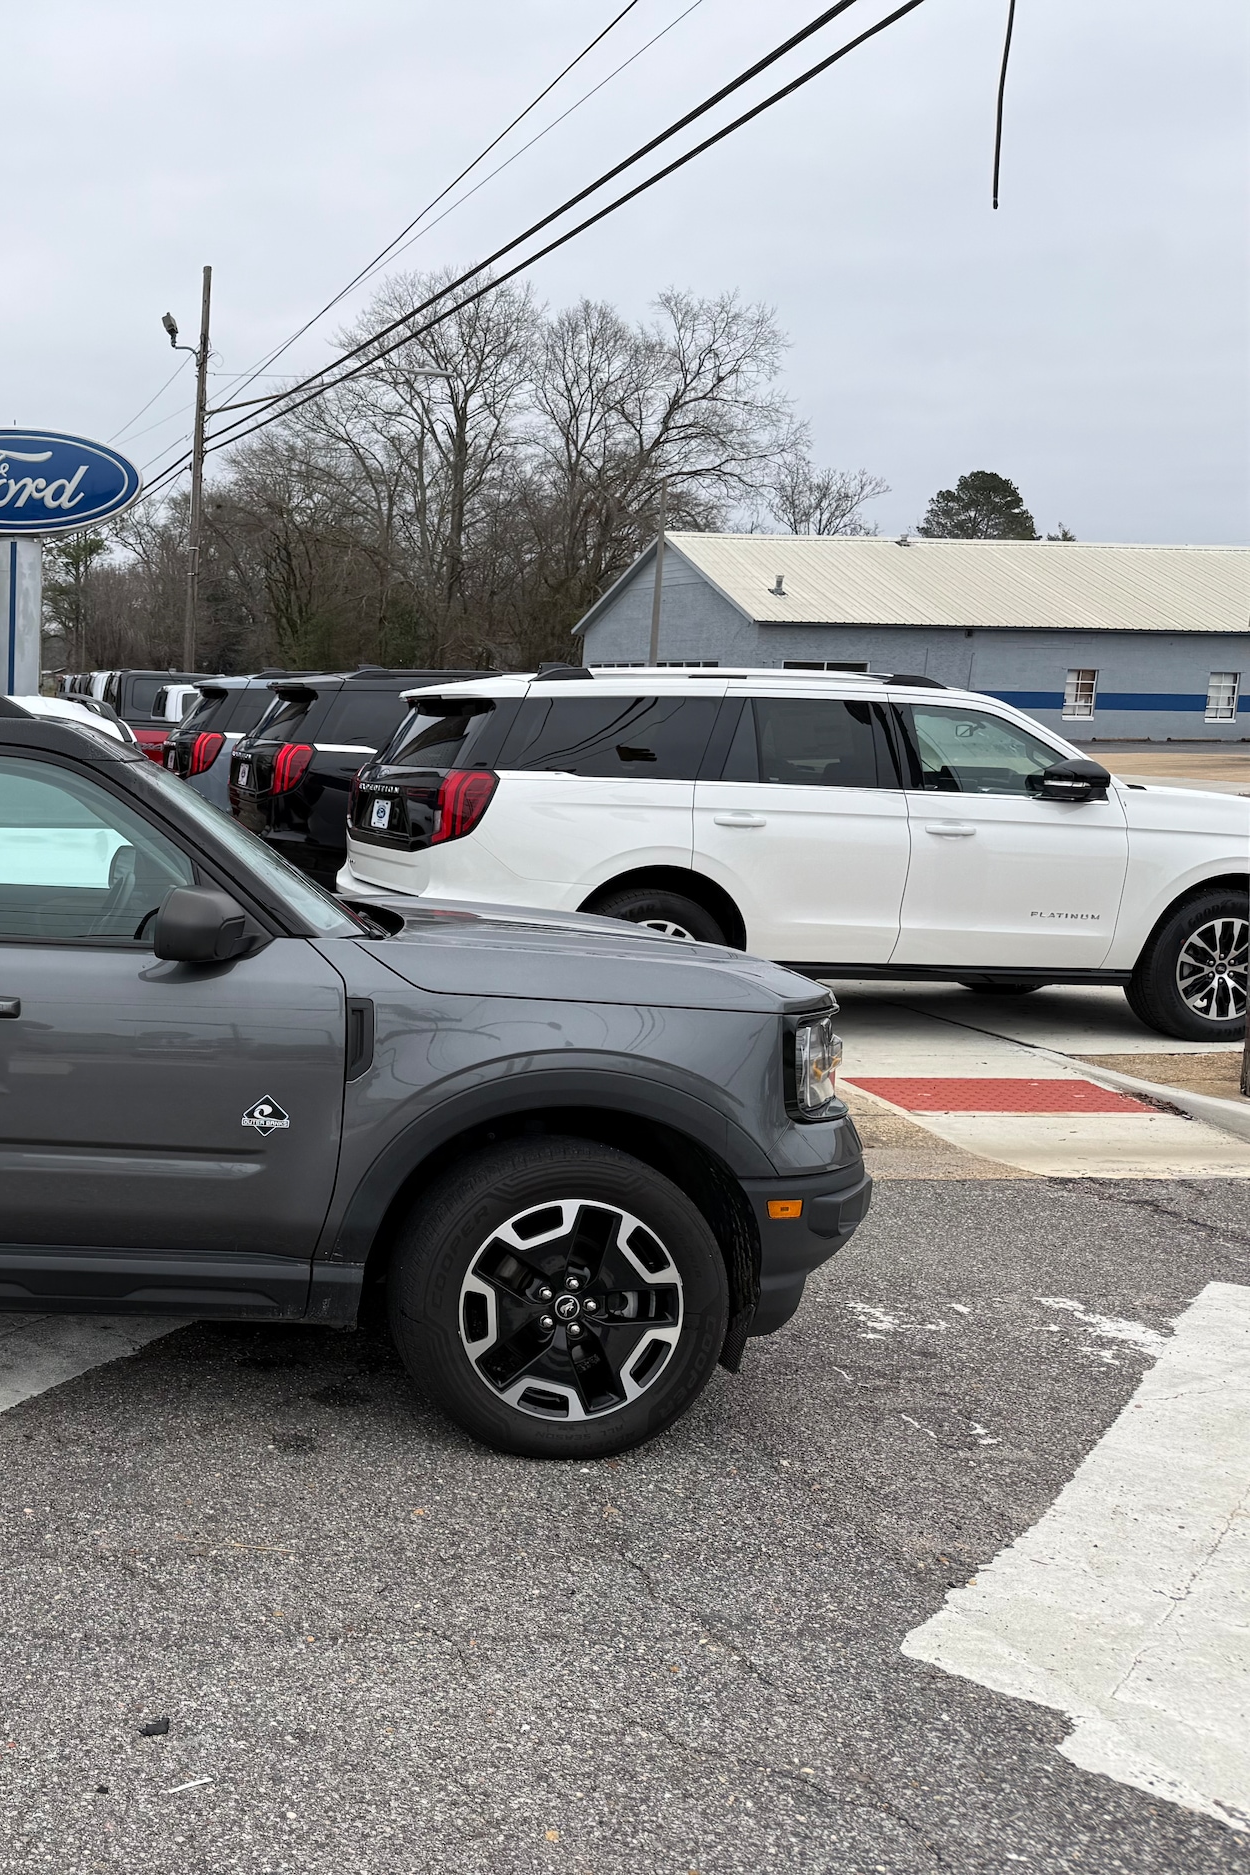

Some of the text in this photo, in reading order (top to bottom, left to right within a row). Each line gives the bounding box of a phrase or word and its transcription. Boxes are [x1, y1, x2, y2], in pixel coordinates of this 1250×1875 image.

[1030, 911, 1101, 921] PLATINUM
[431, 1202, 491, 1311] COOPER
[658, 1314, 717, 1421] COOPER
[534, 1424, 624, 1441] ALL SEASON
